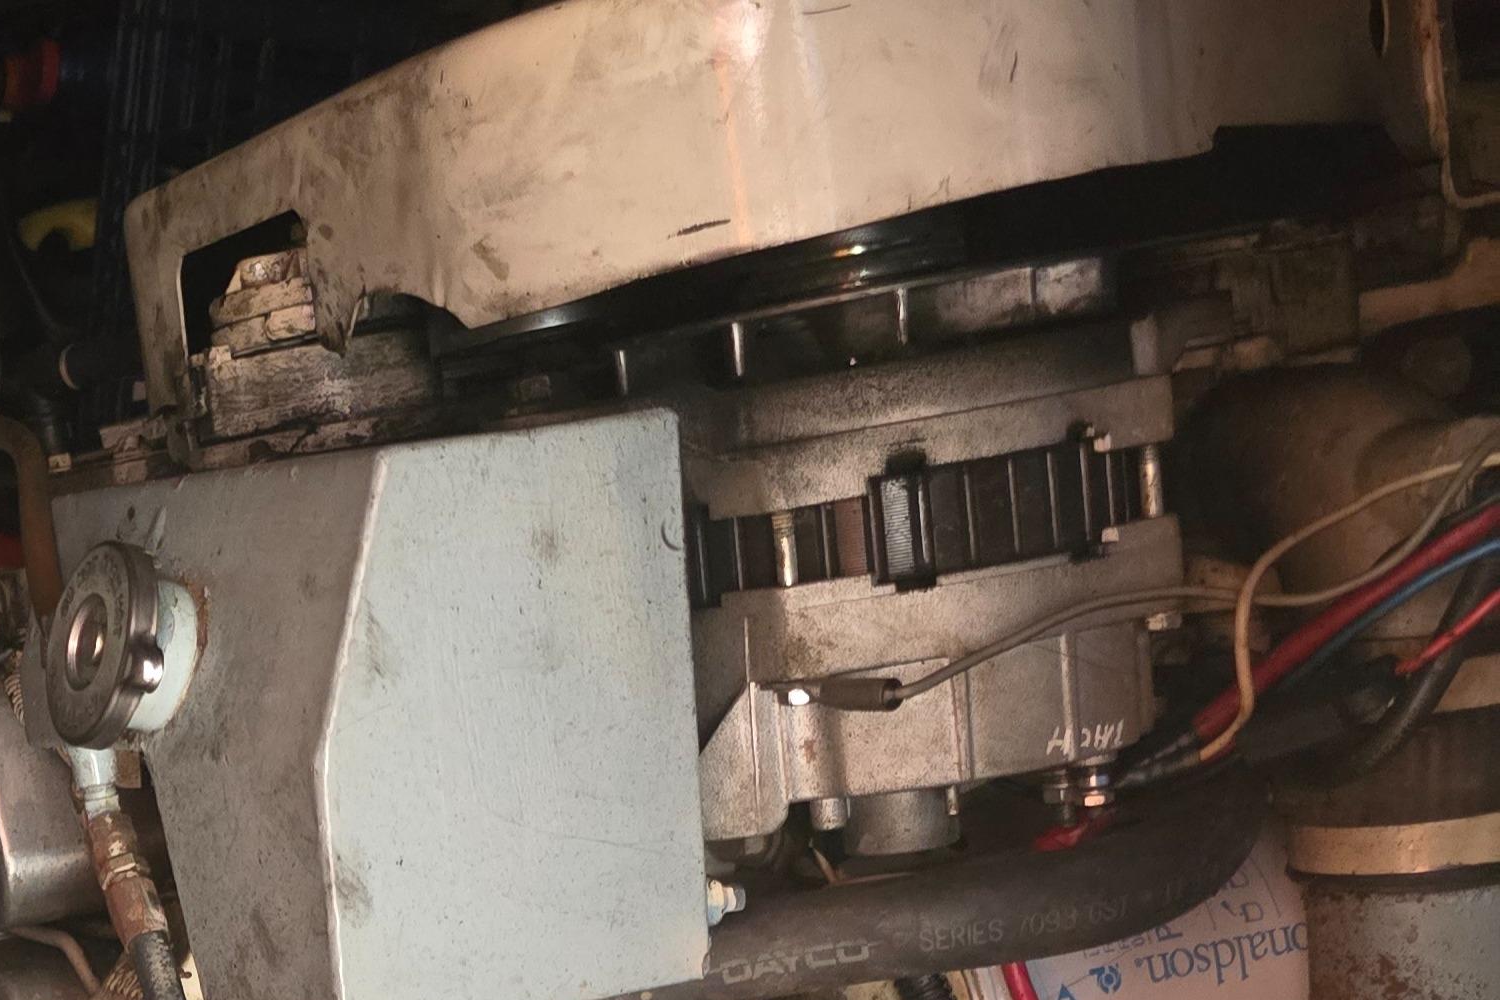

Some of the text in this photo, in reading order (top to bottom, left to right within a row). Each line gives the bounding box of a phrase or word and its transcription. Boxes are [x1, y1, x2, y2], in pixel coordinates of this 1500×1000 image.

[1046, 718, 1124, 756] TACH
[717, 937, 874, 985] DAYCO
[919, 919, 1004, 950] SERIES
